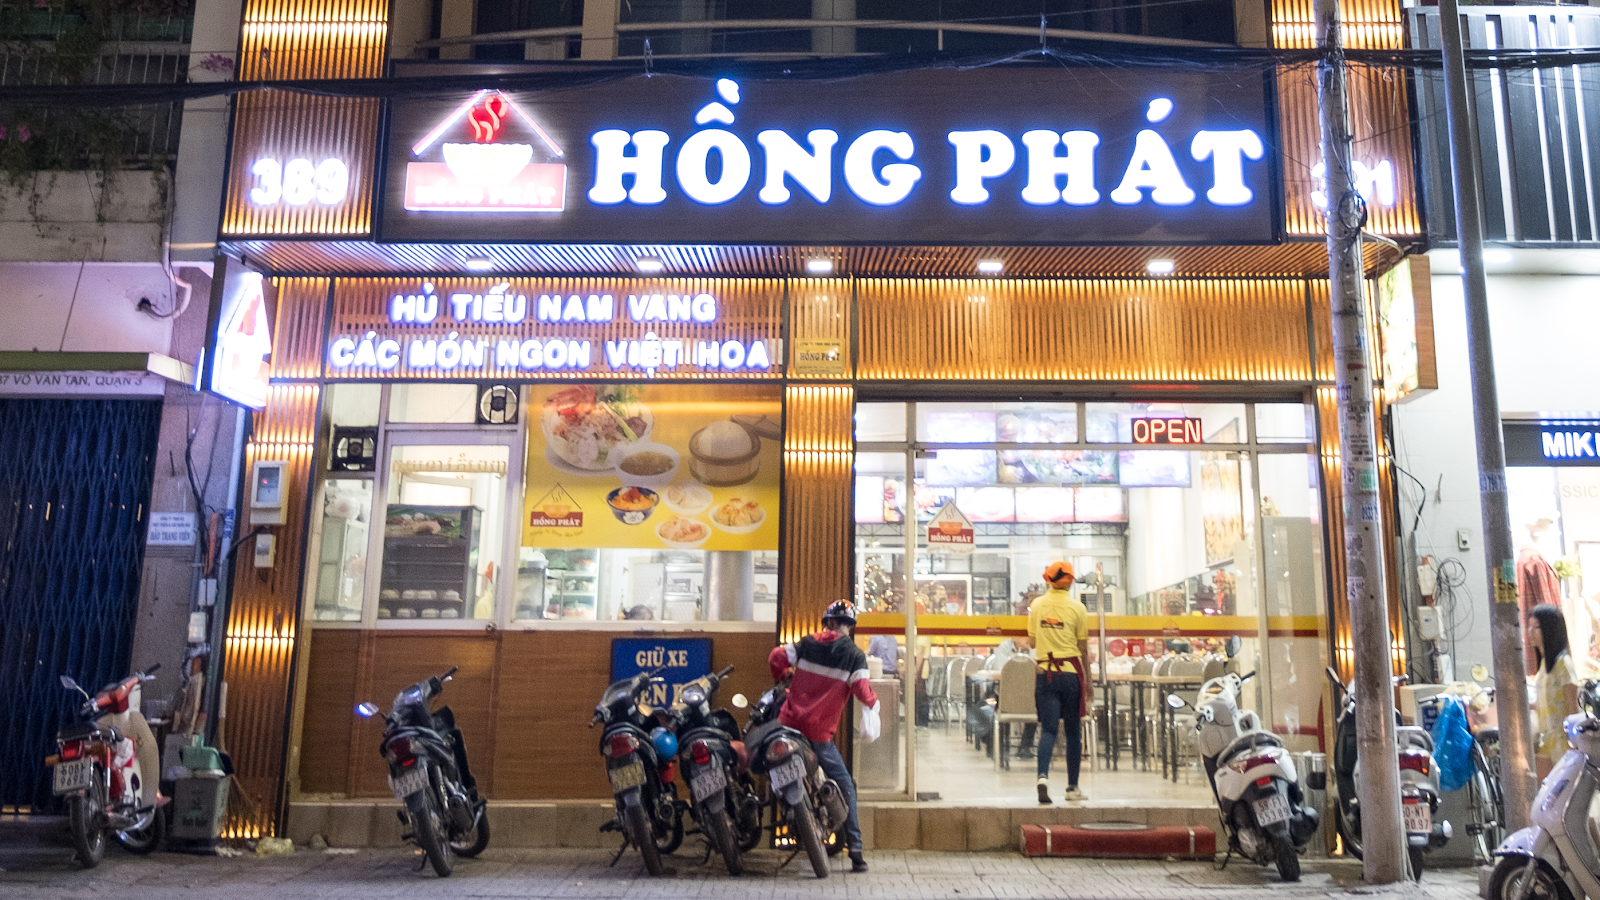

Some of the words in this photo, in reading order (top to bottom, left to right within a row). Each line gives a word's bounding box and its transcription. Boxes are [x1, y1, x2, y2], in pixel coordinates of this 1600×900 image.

[587, 77, 922, 205] HỒNG
[947, 97, 1264, 206] PHÁT
[251, 158, 348, 205] 389
[451, 281, 527, 324] TIẾU
[538, 294, 614, 323] NAM
[329, 331, 401, 370] CÁC
[407, 331, 485, 370] MÓN
[496, 339, 591, 370] NGON
[605, 331, 684, 378] VIỆT
[698, 339, 770, 370] HOA
[1133, 418, 1201, 444] OPEN
[667, 650, 688, 667] XE
